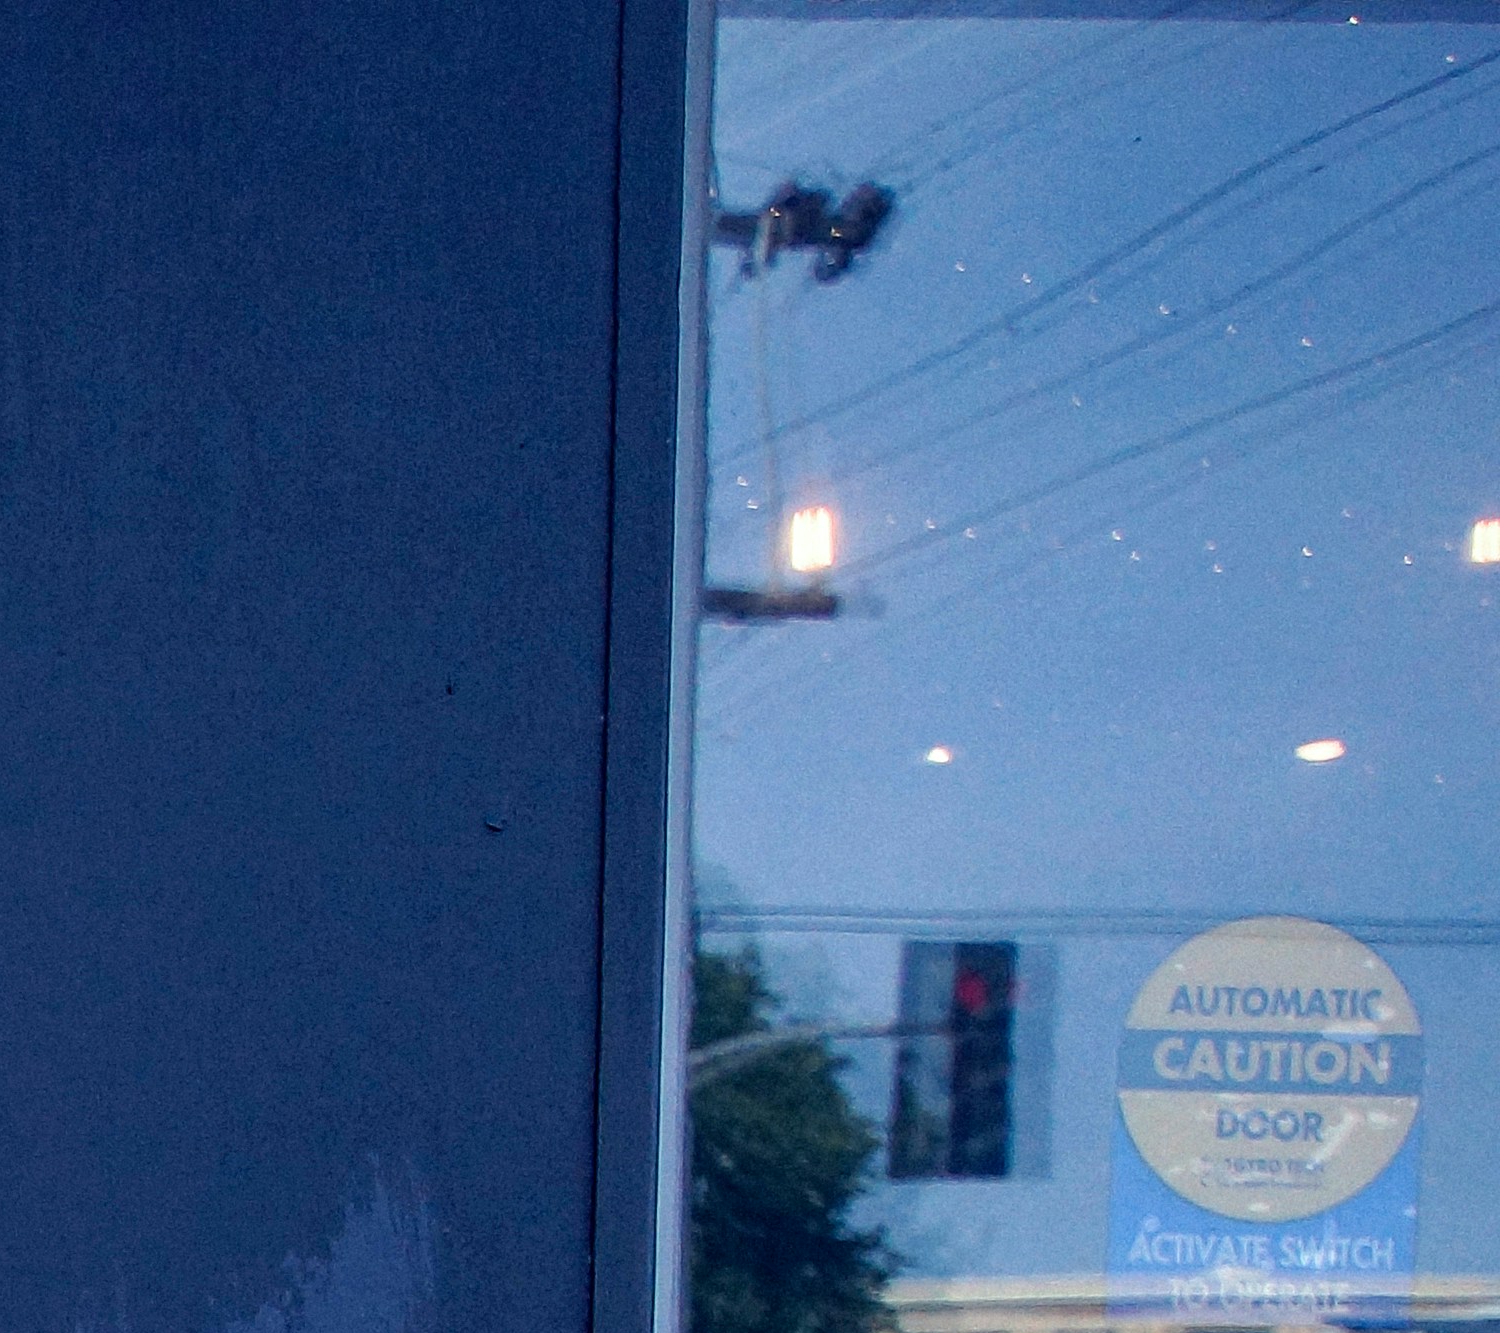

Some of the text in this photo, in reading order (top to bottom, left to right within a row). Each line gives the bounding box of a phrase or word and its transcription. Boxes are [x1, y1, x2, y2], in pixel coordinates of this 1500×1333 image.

[1169, 984, 1382, 1020] AUTOMATIC
[1153, 1036, 1391, 1085] CAUTION
[1216, 1108, 1324, 1143] DOOR
[1129, 1234, 1396, 1271] ACTIVATE SWITCH
